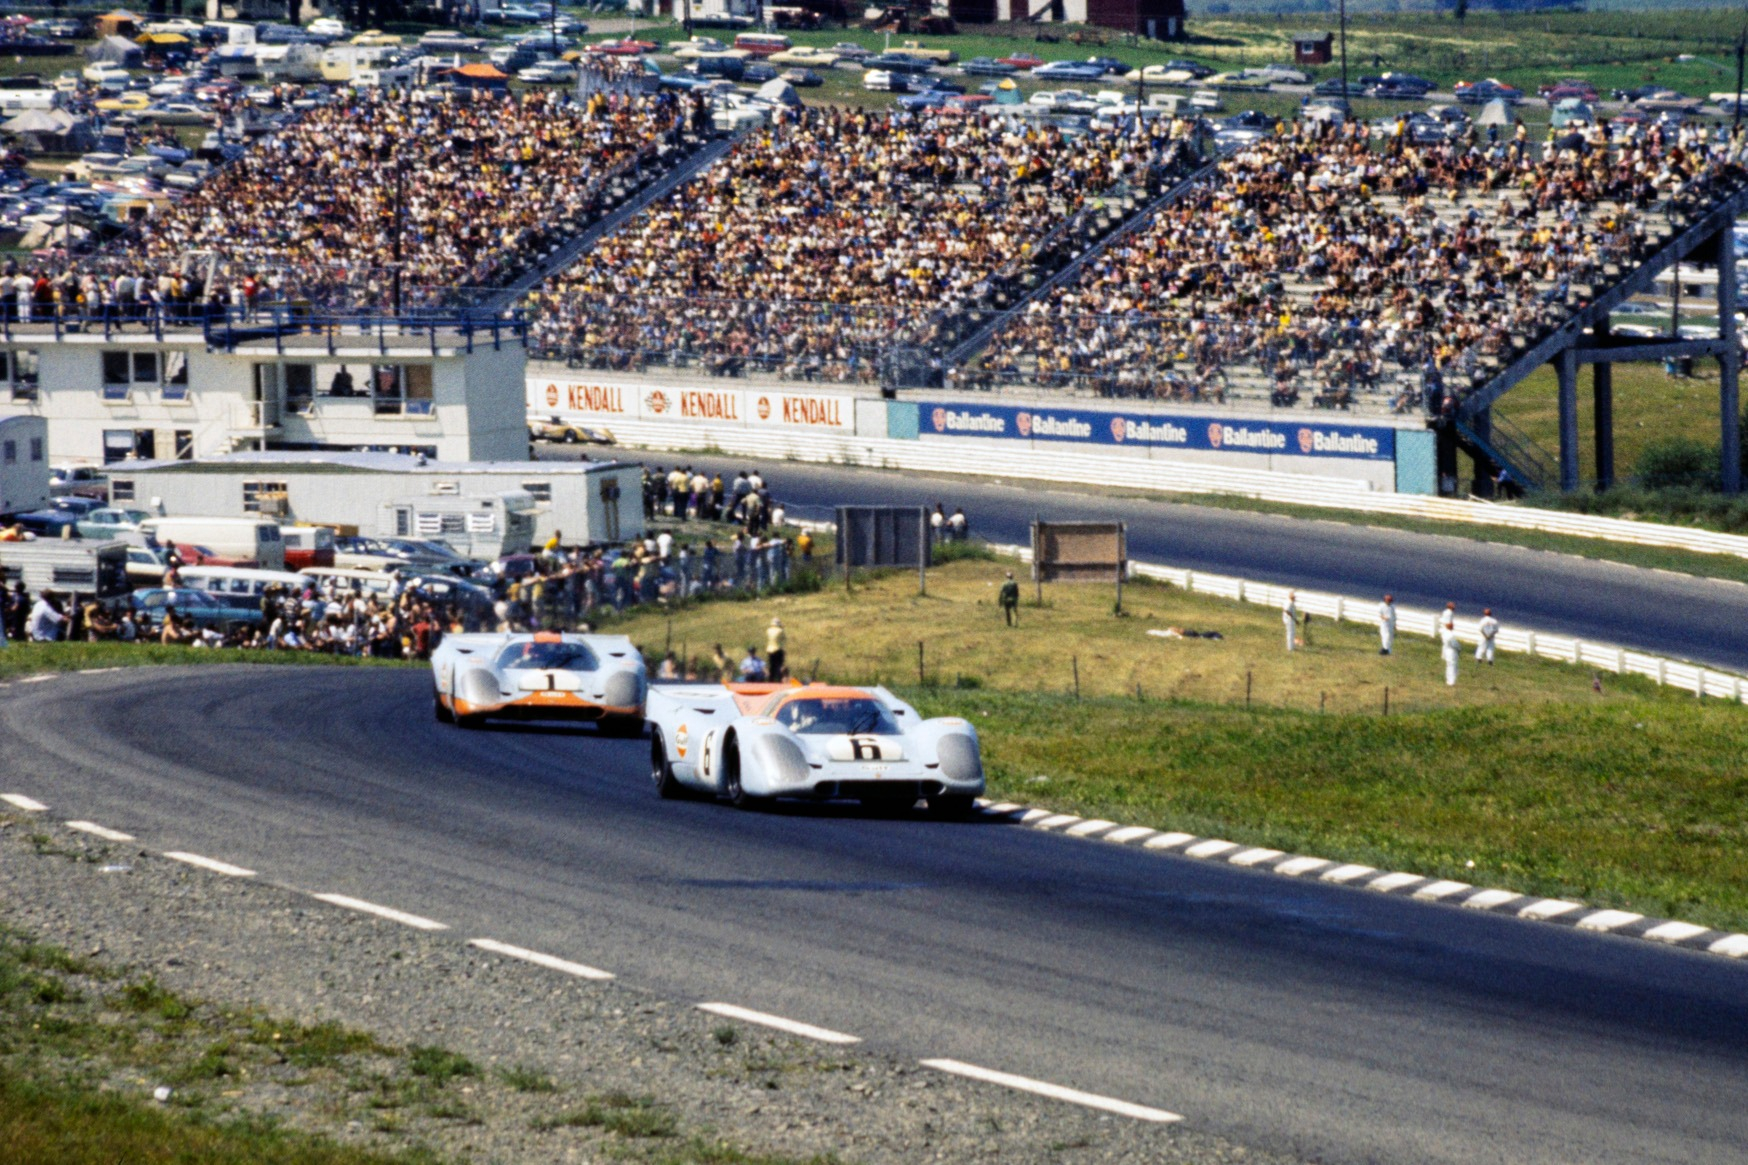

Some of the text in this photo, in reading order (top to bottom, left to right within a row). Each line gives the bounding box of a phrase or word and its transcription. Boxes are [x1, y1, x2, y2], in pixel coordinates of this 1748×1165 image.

[568, 385, 624, 412] KENDALL
[681, 391, 738, 419] KENDALL
[783, 397, 842, 425] KENDALL
[946, 411, 1005, 432] Ballantine
[1032, 415, 1091, 437] Ballantine
[1126, 420, 1187, 443] Ballantine
[1223, 426, 1286, 449] Ballantine
[1313, 430, 1378, 454] Ballantine
[545, 673, 555, 690] 1
[849, 738, 882, 761] 6
